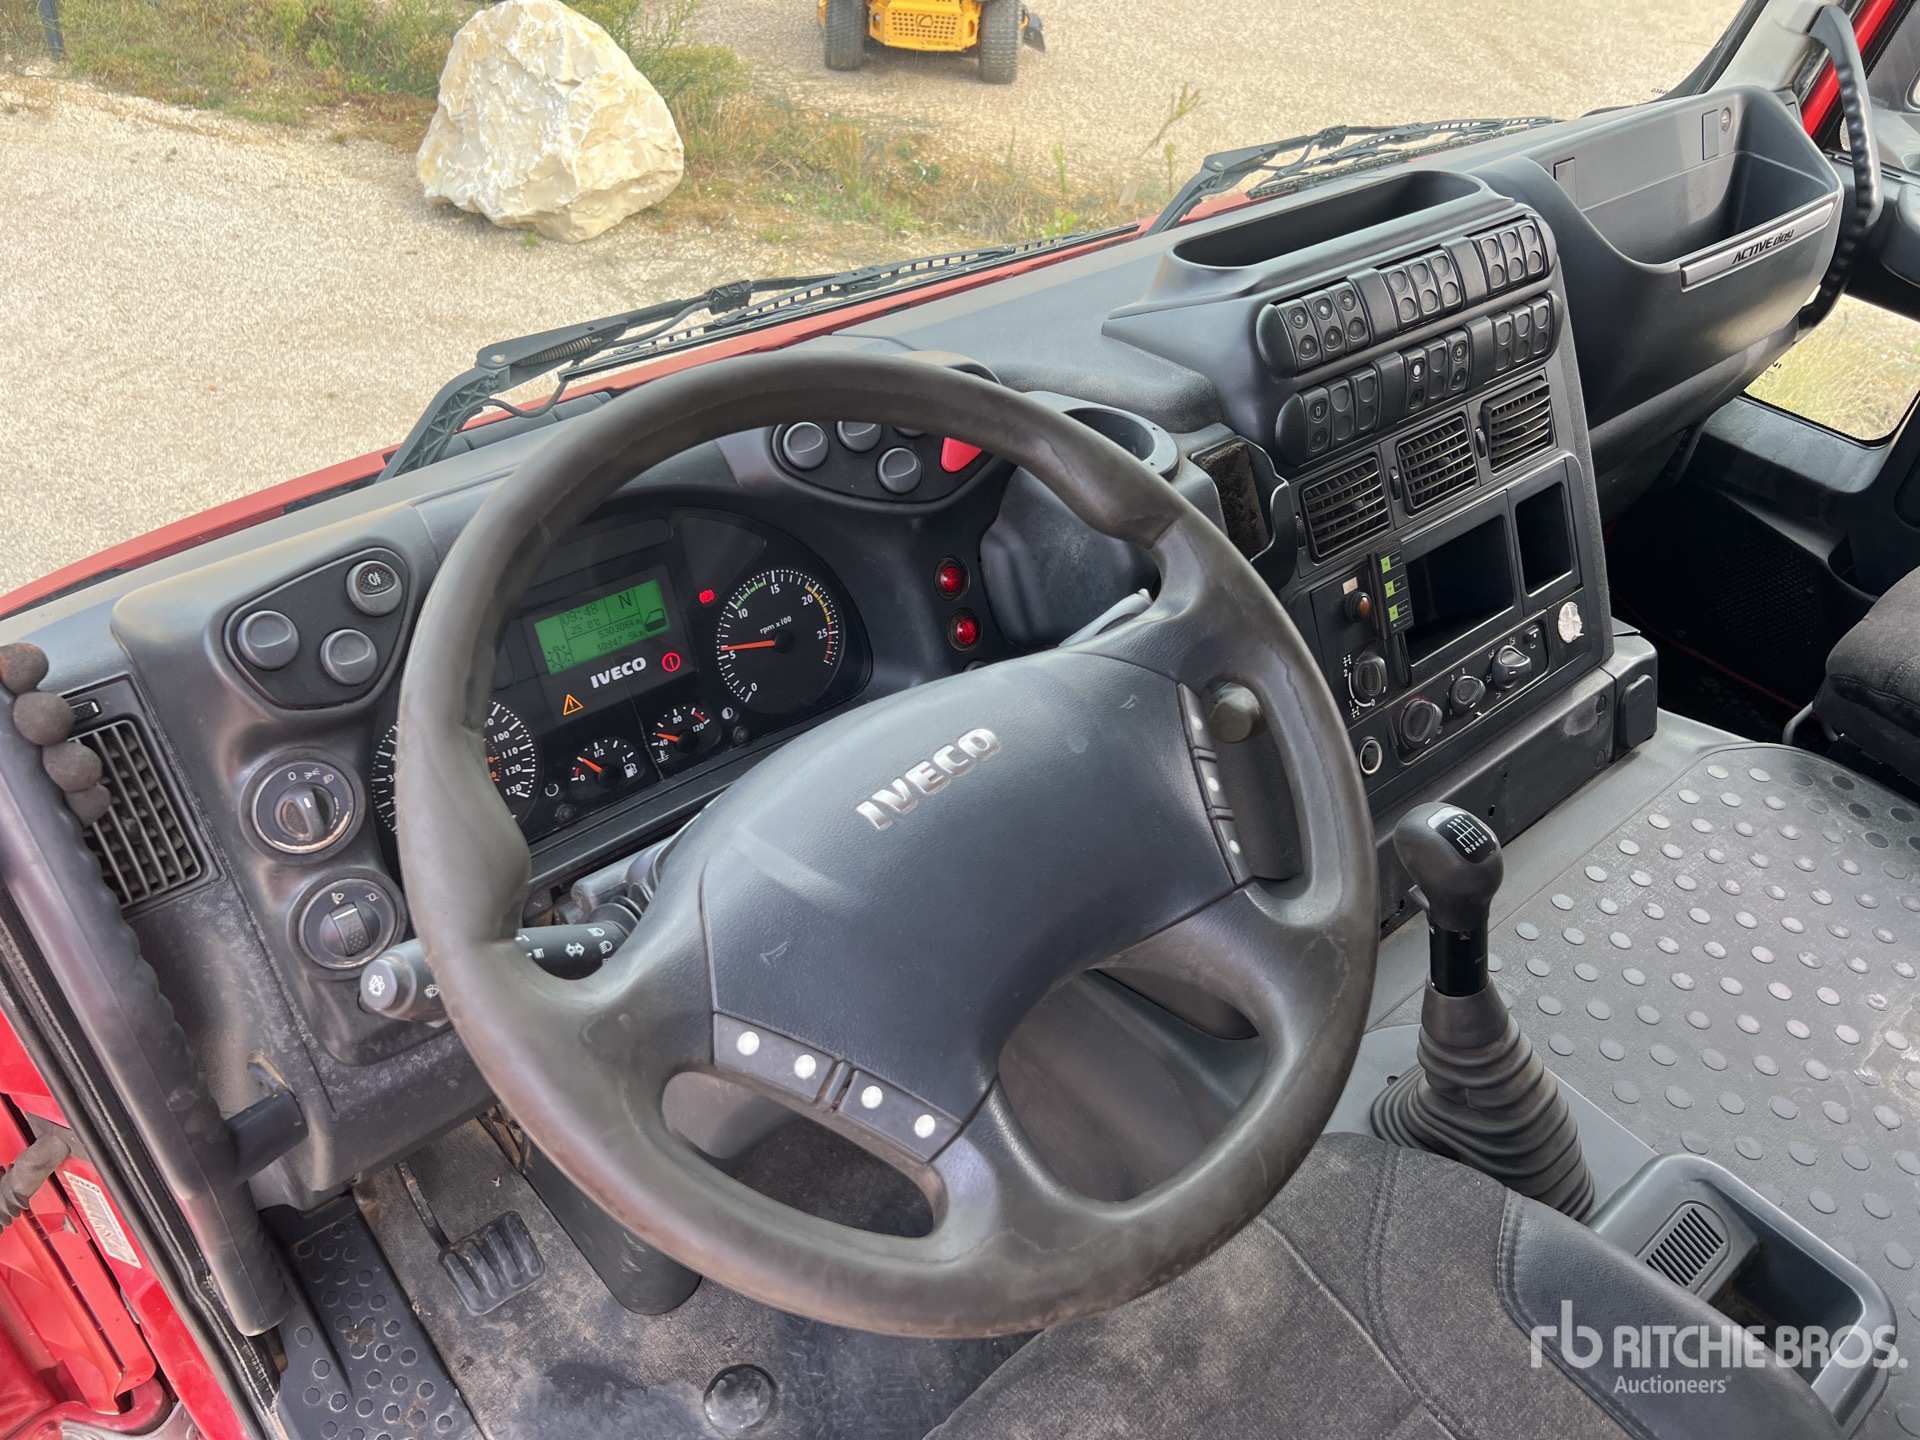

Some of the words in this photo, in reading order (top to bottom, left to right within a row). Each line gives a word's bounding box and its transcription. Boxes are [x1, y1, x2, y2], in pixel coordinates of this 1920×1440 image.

[770, 583, 780, 595] 15
[618, 591, 632, 610] N
[801, 594, 813, 606] 20
[738, 608, 748, 619] 10
[760, 624, 775, 634] rpm
[816, 628, 828, 639] 25
[729, 650, 736, 660] 5
[590, 657, 647, 689] IVECO
[751, 682, 758, 692] 0
[672, 715, 682, 725] 80
[692, 723, 705, 733] 120
[493, 731, 510, 743] 100
[658, 739, 668, 747] 40
[502, 747, 519, 759] 110
[593, 748, 605, 758] 1/2
[505, 764, 522, 776] 120
[579, 774, 586, 782] 0
[855, 728, 1001, 831] IVECO
[505, 784, 522, 796] 130
